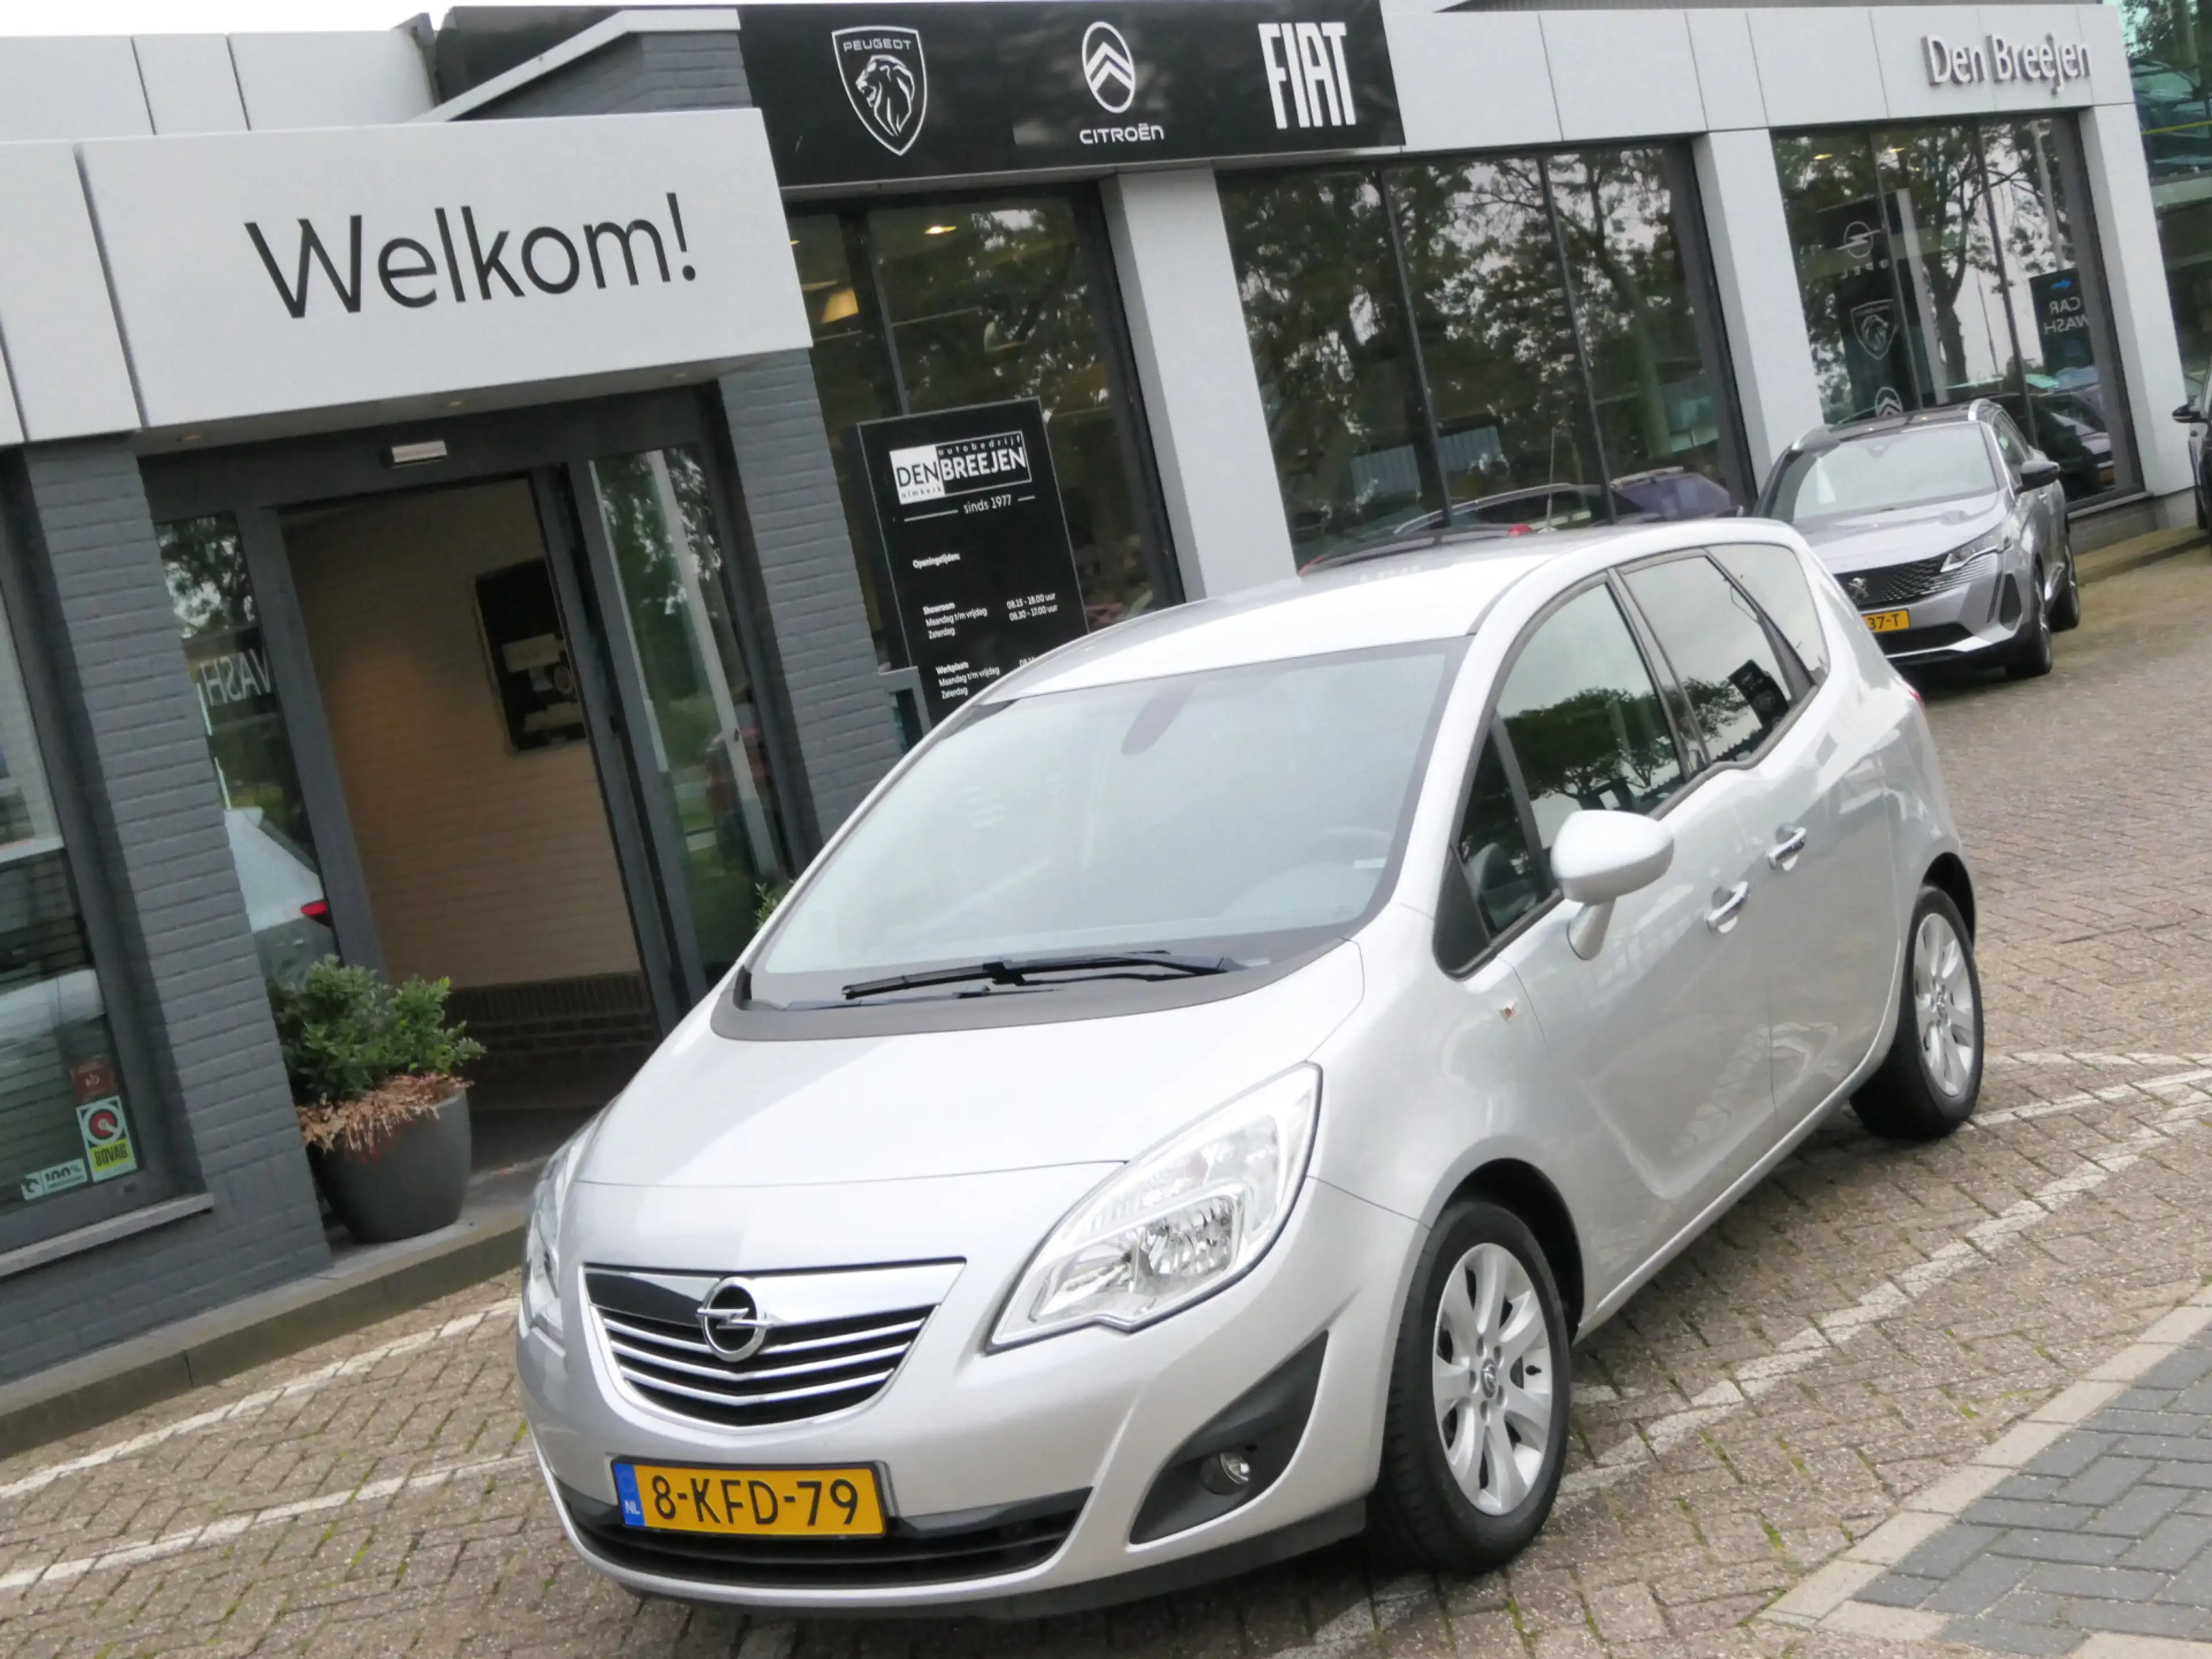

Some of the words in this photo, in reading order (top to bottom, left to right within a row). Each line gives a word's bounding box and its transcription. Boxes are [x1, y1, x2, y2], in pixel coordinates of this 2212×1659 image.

[843, 39, 912, 52] PEUGEOT
[1921, 35, 1988, 86] Den
[1985, 31, 2092, 96] Breejen
[1258, 22, 1356, 129] FIAT
[244, 192, 696, 319] Welkom!
[896, 461, 940, 487] DEN
[940, 446, 1026, 481] BREEJEN
[963, 500, 988, 514] sinds
[990, 494, 1012, 509] 1977
[923, 603, 955, 615] Showroom
[925, 615, 955, 627] Maandag
[938, 675, 967, 687] Maandag
[624, 1500, 641, 1514] NL
[652, 1475, 858, 1526] 8-KFD-79
